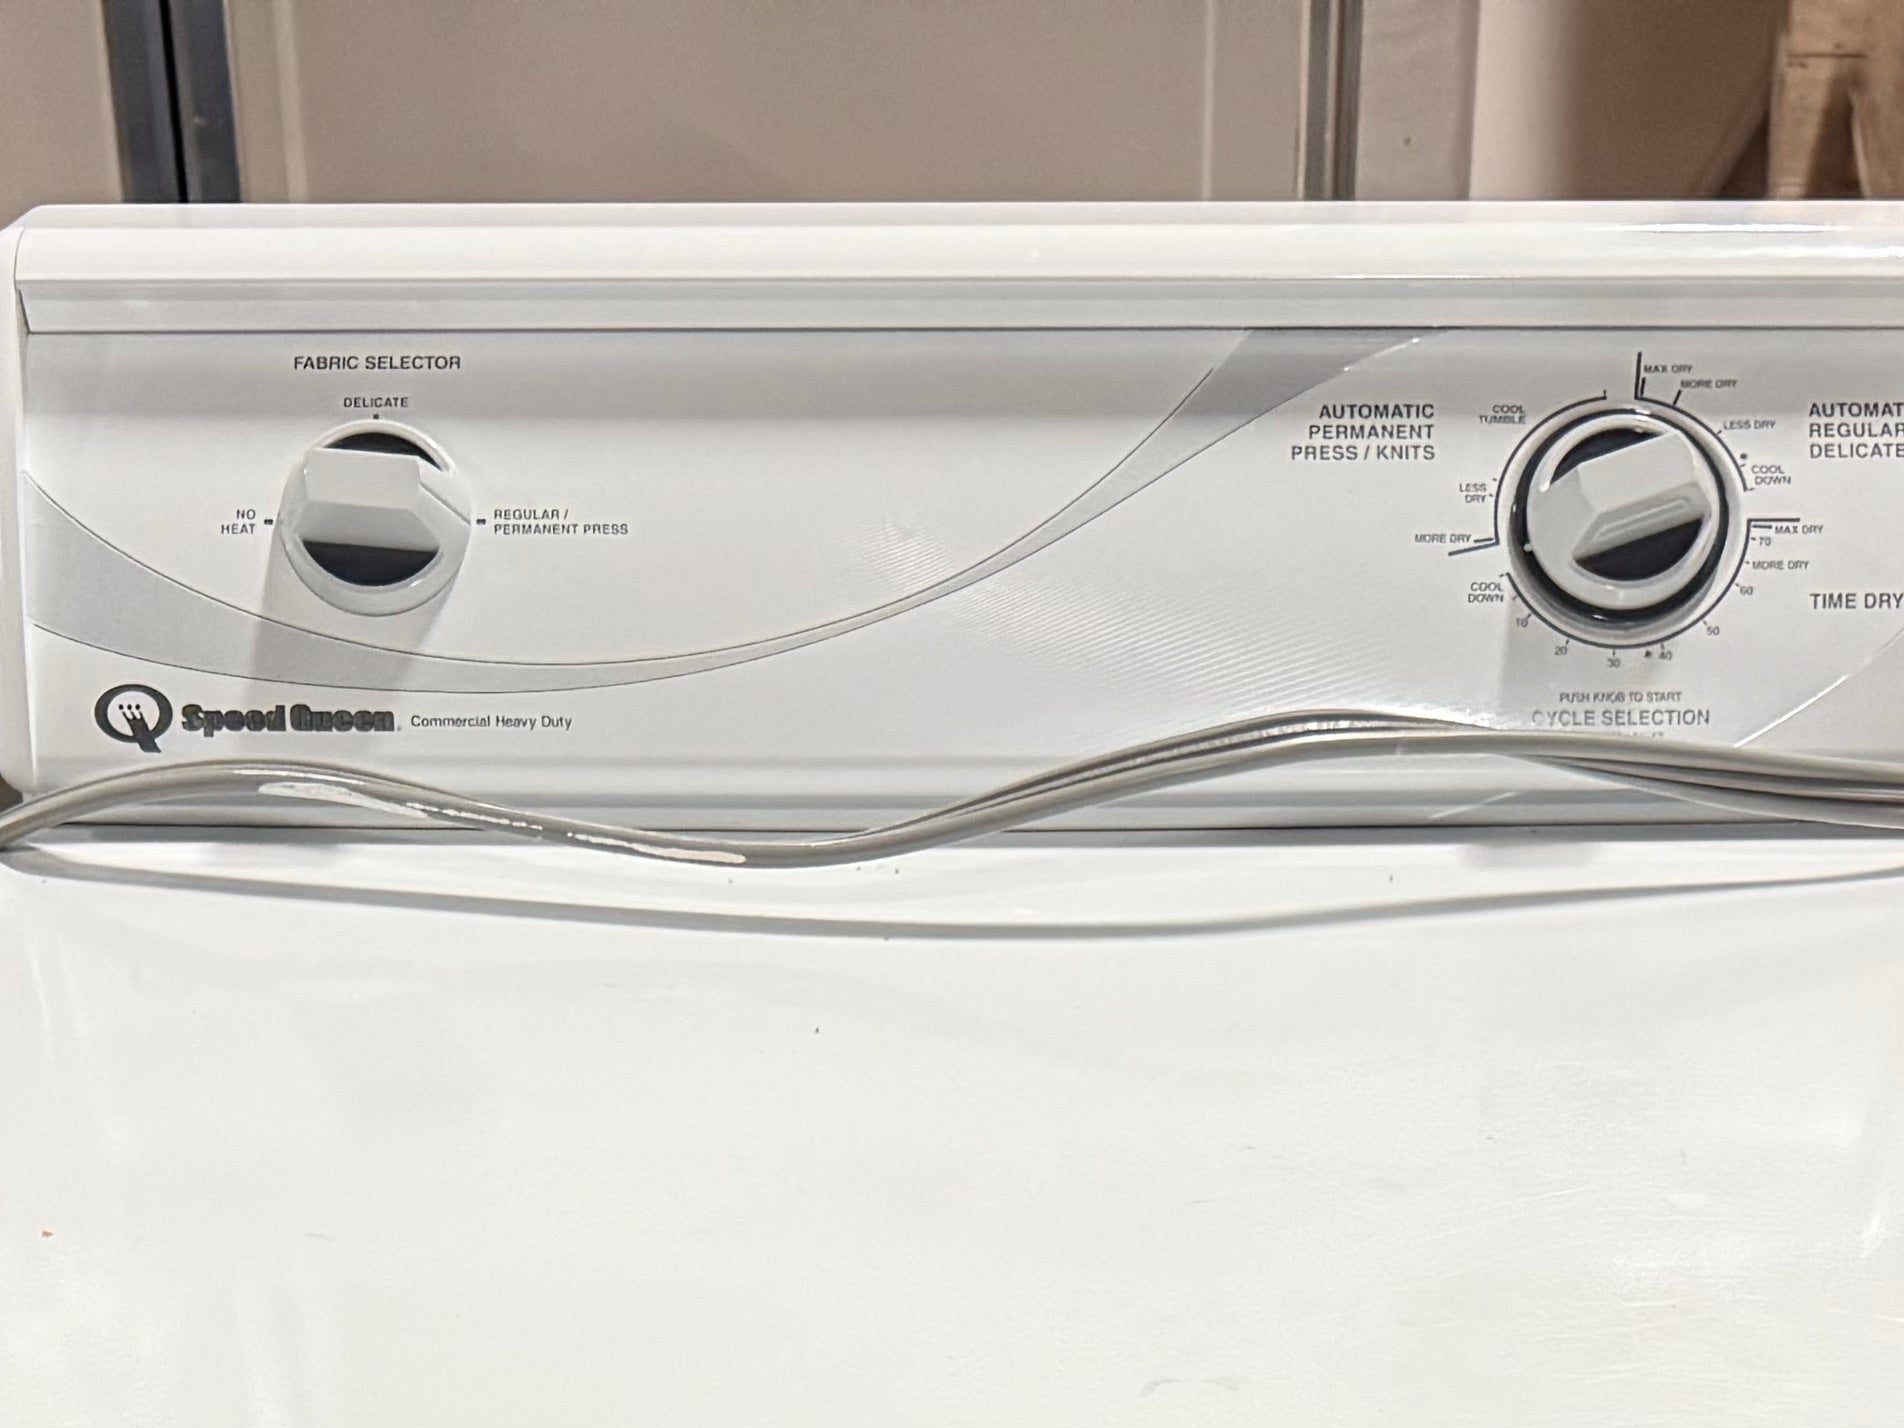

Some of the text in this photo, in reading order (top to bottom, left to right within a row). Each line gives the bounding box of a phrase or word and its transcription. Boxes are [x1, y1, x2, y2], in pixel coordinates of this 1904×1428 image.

[293, 355, 461, 371] FABRIC SELECTOR
[1670, 363, 1694, 375] DRY
[1679, 378, 1739, 390] MORE DRY
[343, 396, 409, 409] DELICATE
[1318, 402, 1435, 420] AUTOMATIC
[1491, 403, 1527, 416] COOL
[1477, 414, 1528, 425] TUMBLE
[1722, 418, 1777, 431] LESS DRY
[1308, 423, 1435, 440] PERMANENT
[1290, 444, 1359, 461] PRESS
[1376, 444, 1436, 461] KNITS
[1750, 463, 1786, 475] COOL
[1754, 475, 1792, 486] DOWN
[1458, 482, 1488, 493] LESS
[1464, 493, 1488, 504] DRY
[236, 508, 257, 521] NO
[493, 508, 560, 521] REGULAR
[220, 522, 256, 535] HEAT
[493, 522, 629, 536] PERMANENT PRESS
[1774, 524, 1825, 535] MAX DRY
[1414, 532, 1473, 545] MORE DRY
[1758, 535, 1772, 547] 70
[1751, 559, 1811, 571] MORE DRY
[1469, 581, 1505, 593] COOL
[1738, 585, 1756, 597] 60
[1467, 592, 1505, 604] DOWN
[1809, 591, 1904, 611] TIME DRY
[1515, 617, 1529, 629] 10
[1706, 625, 1721, 637] 50
[1553, 645, 1569, 657] 20
[1657, 649, 1673, 661] 40
[1605, 656, 1622, 669] 30
[1558, 691, 1591, 704] PUSH
[1628, 690, 1644, 703] TO
[1645, 690, 1683, 704] START
[181, 704, 286, 737] Speed
[290, 703, 396, 732] Queen
[409, 713, 492, 730] Commercial
[494, 713, 538, 732] Heavy
[539, 713, 574, 732] Duty
[1531, 708, 1711, 727] CYCLE SELECTION
